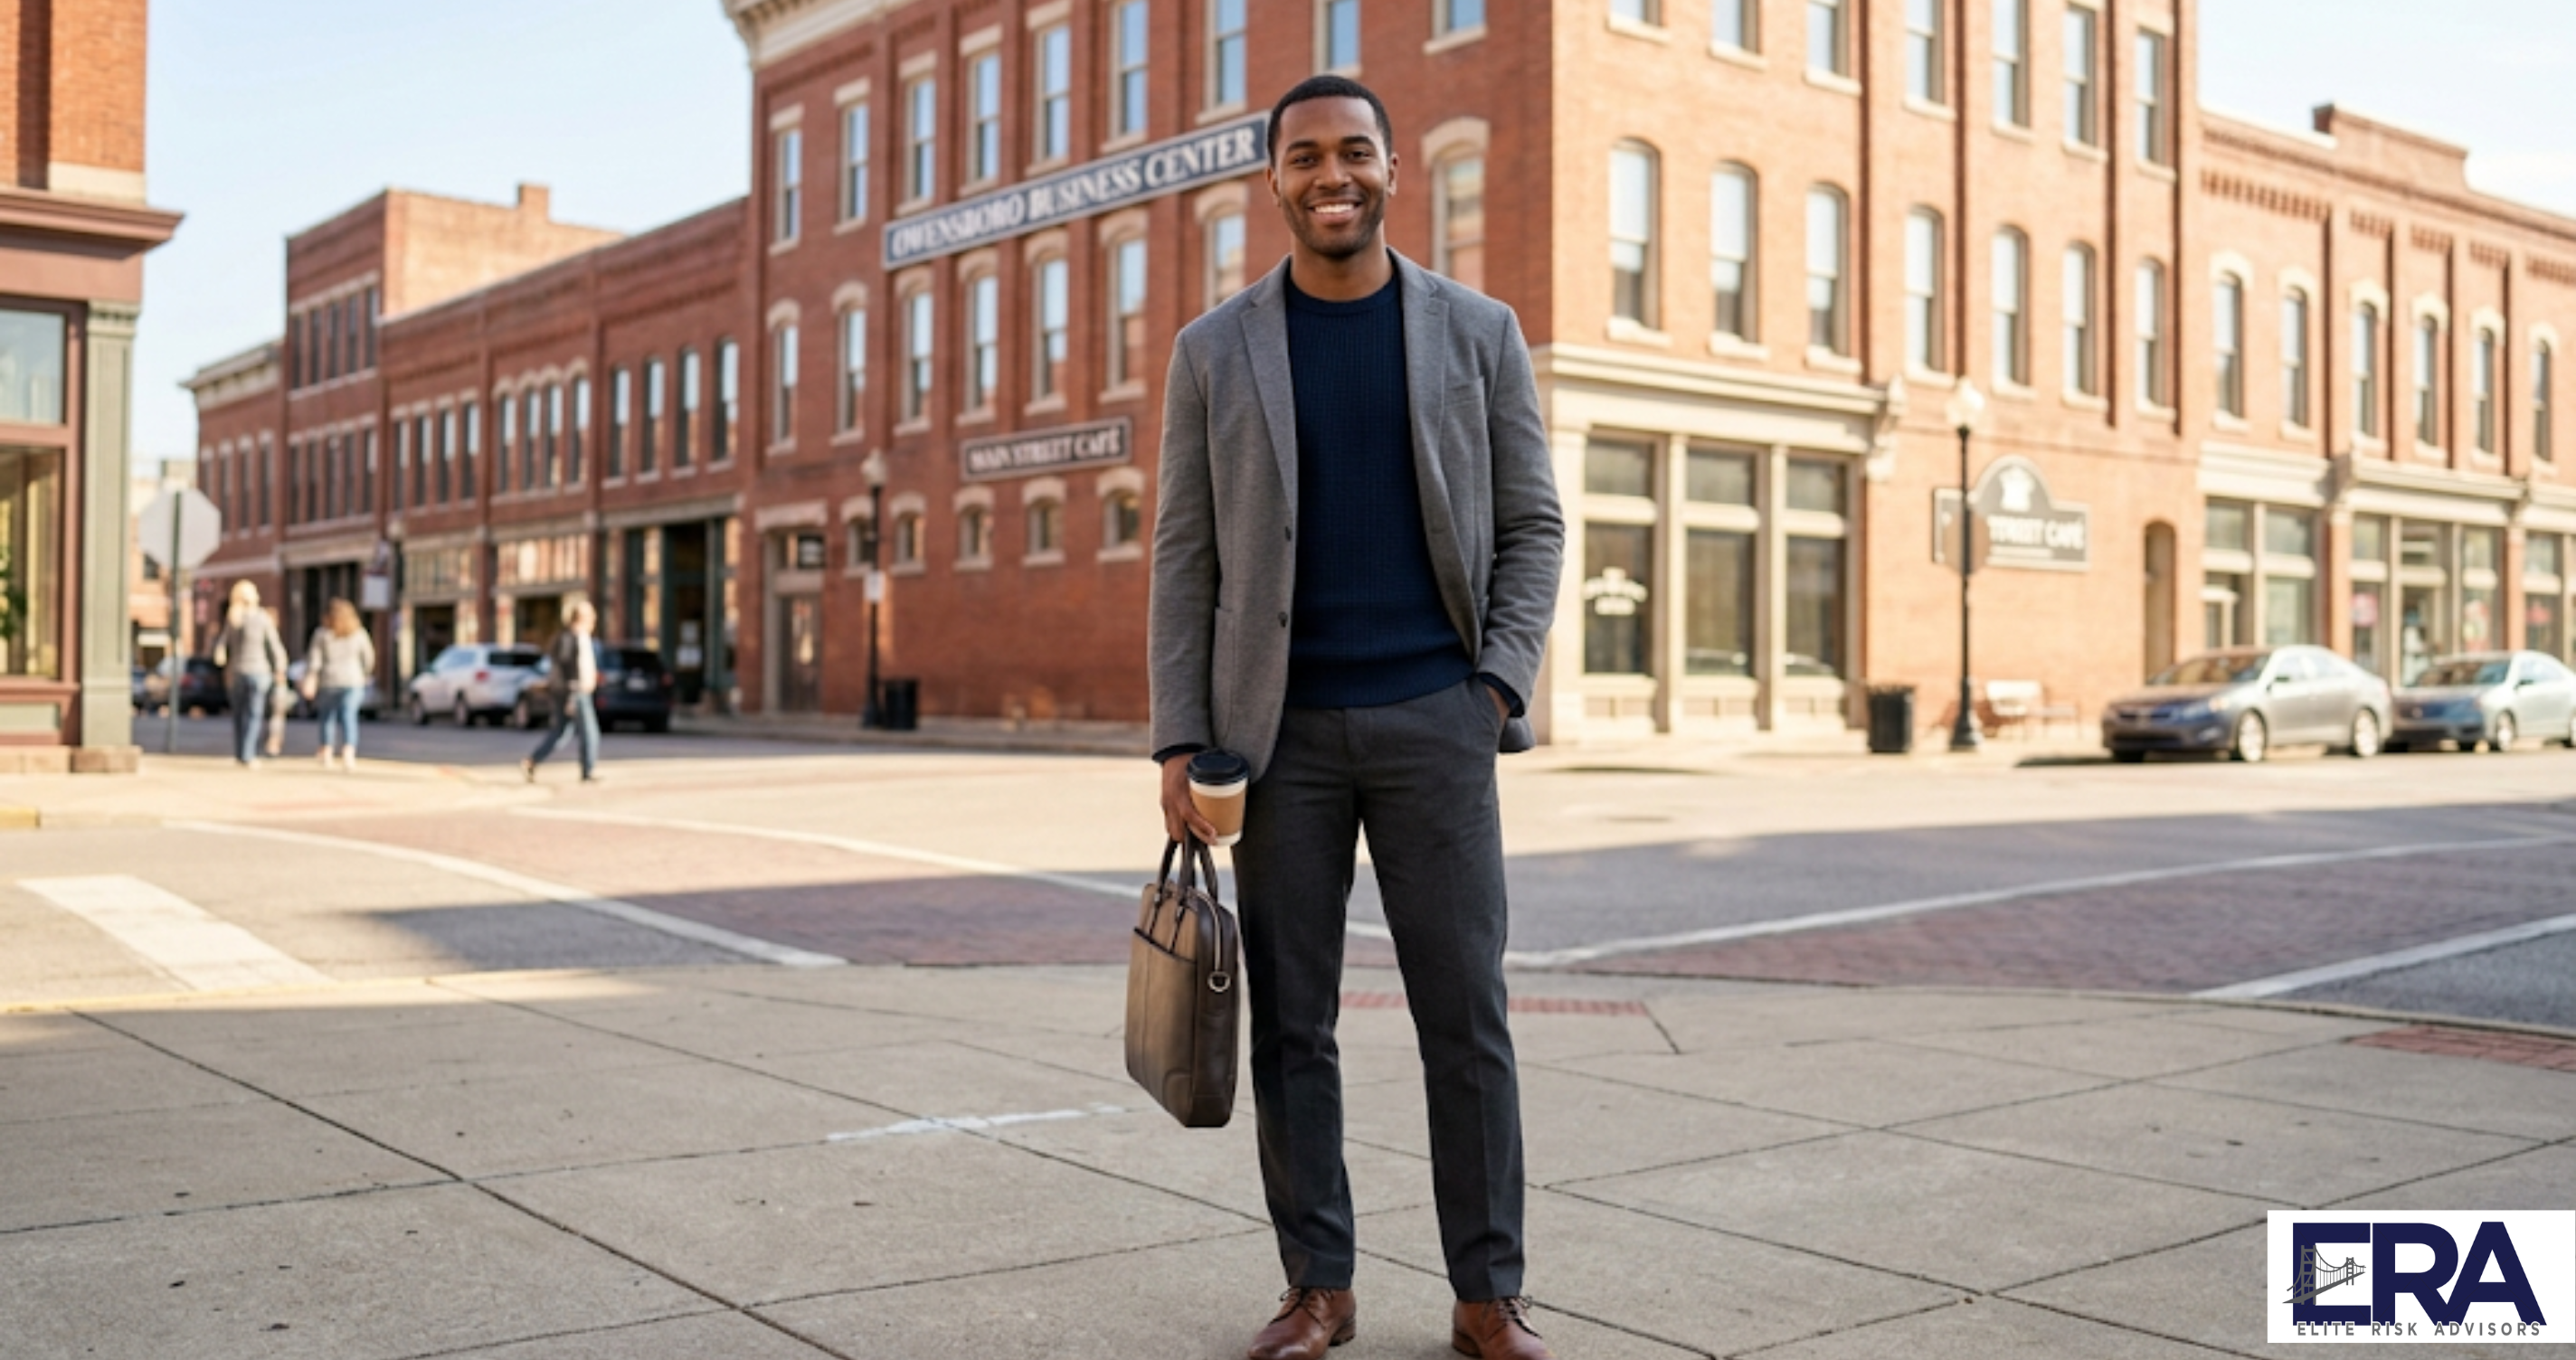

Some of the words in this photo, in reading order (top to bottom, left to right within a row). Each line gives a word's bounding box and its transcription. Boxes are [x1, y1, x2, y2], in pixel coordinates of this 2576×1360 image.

[892, 193, 1026, 258] OWENSBORO
[1028, 157, 1142, 222] BUSINESS
[1144, 126, 1256, 188] CENTER
[970, 445, 1011, 471] MAIN
[1011, 436, 1073, 466] STREET
